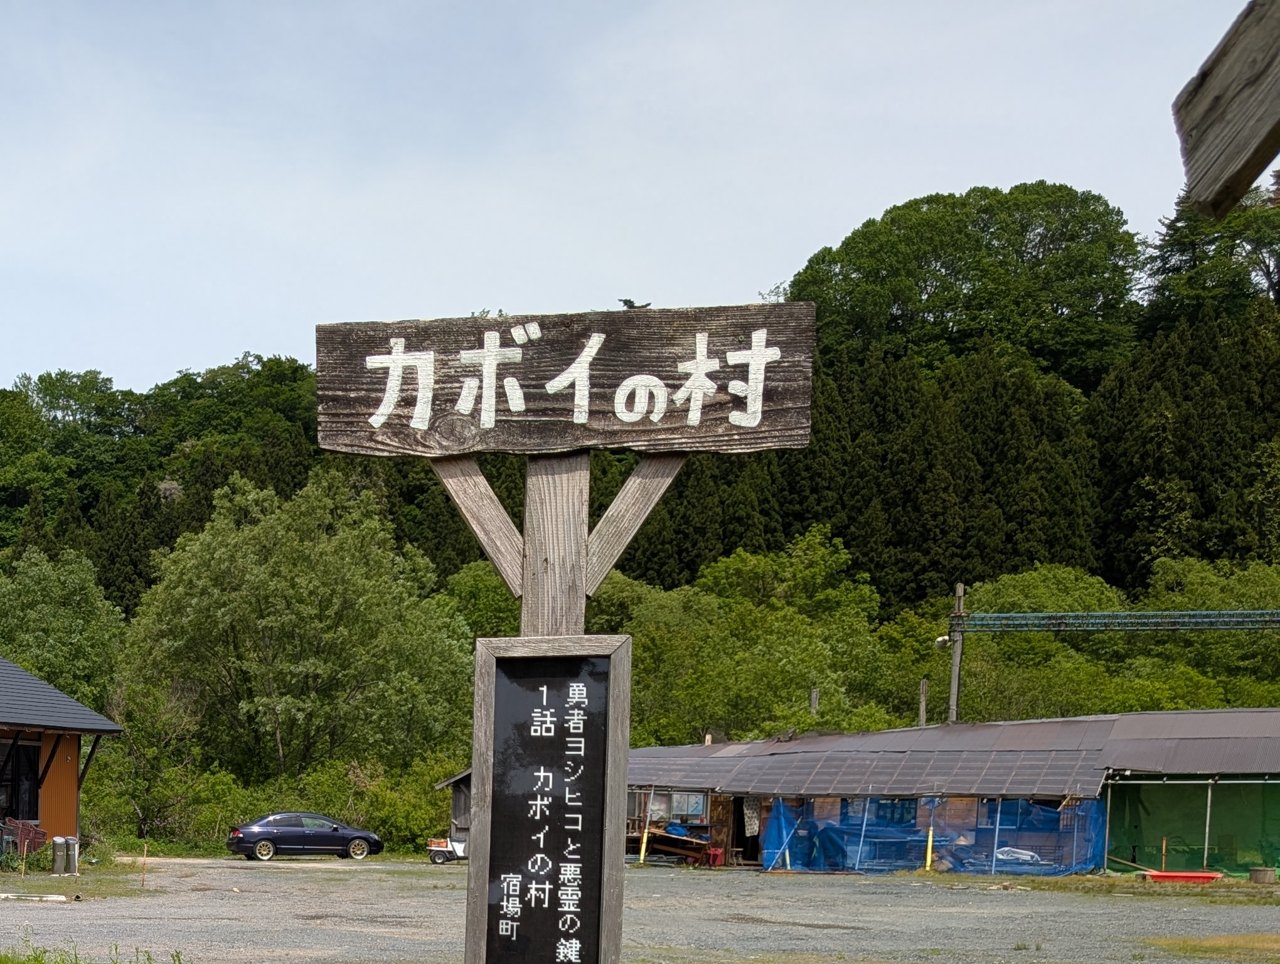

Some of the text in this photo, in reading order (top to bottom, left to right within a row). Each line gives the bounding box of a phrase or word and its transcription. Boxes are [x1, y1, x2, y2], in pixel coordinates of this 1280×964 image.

[365, 322, 781, 431] カボイの村
[524, 684, 558, 908] 1話 カボイの村
[555, 682, 589, 963] 勇者ヨシヒコと悪霊の鍵
[498, 872, 523, 941] 宿場町
